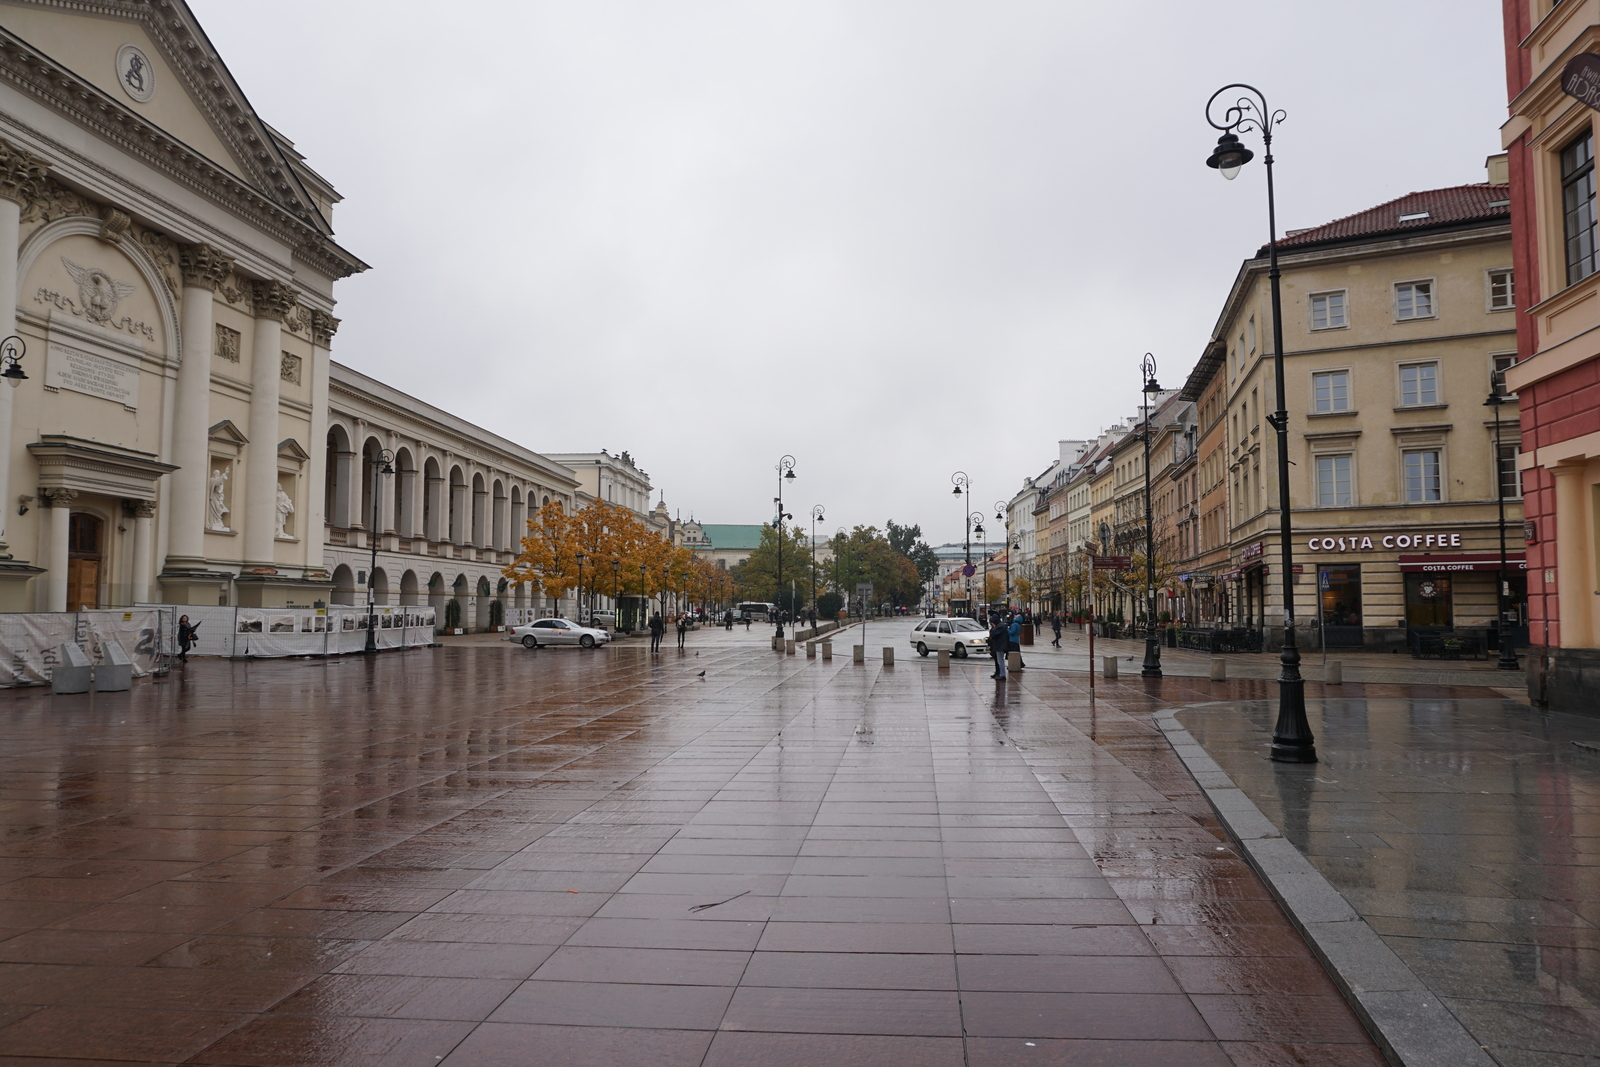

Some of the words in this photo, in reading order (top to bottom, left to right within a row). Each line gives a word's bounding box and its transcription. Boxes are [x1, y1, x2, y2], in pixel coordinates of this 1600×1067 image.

[50, 345, 63, 353] ANNO
[1308, 537, 1373, 551] COSTA
[1382, 533, 1461, 548] COFFEE
